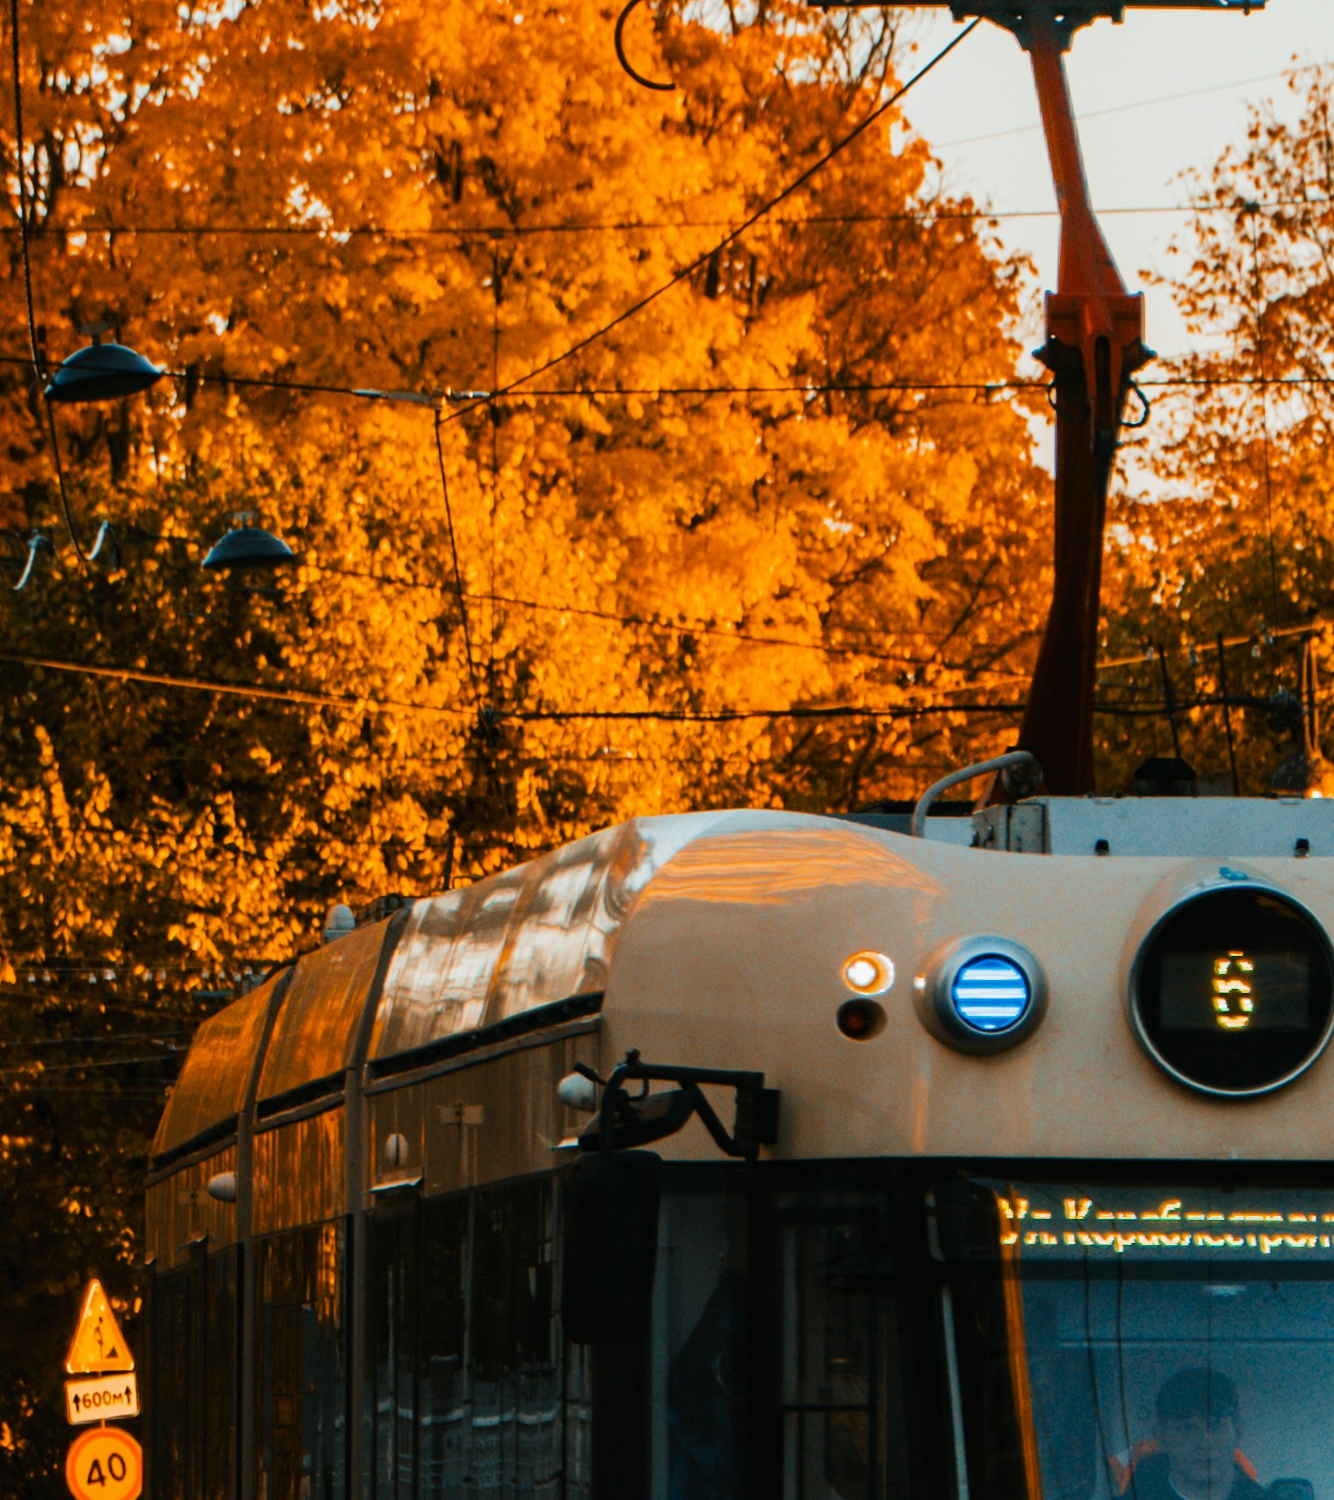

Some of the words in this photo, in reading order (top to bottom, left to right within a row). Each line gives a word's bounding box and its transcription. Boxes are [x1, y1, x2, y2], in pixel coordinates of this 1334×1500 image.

[1212, 949, 1255, 1031] 6
[82, 1389, 124, 1409] 600м
[87, 1452, 126, 1487] 40
